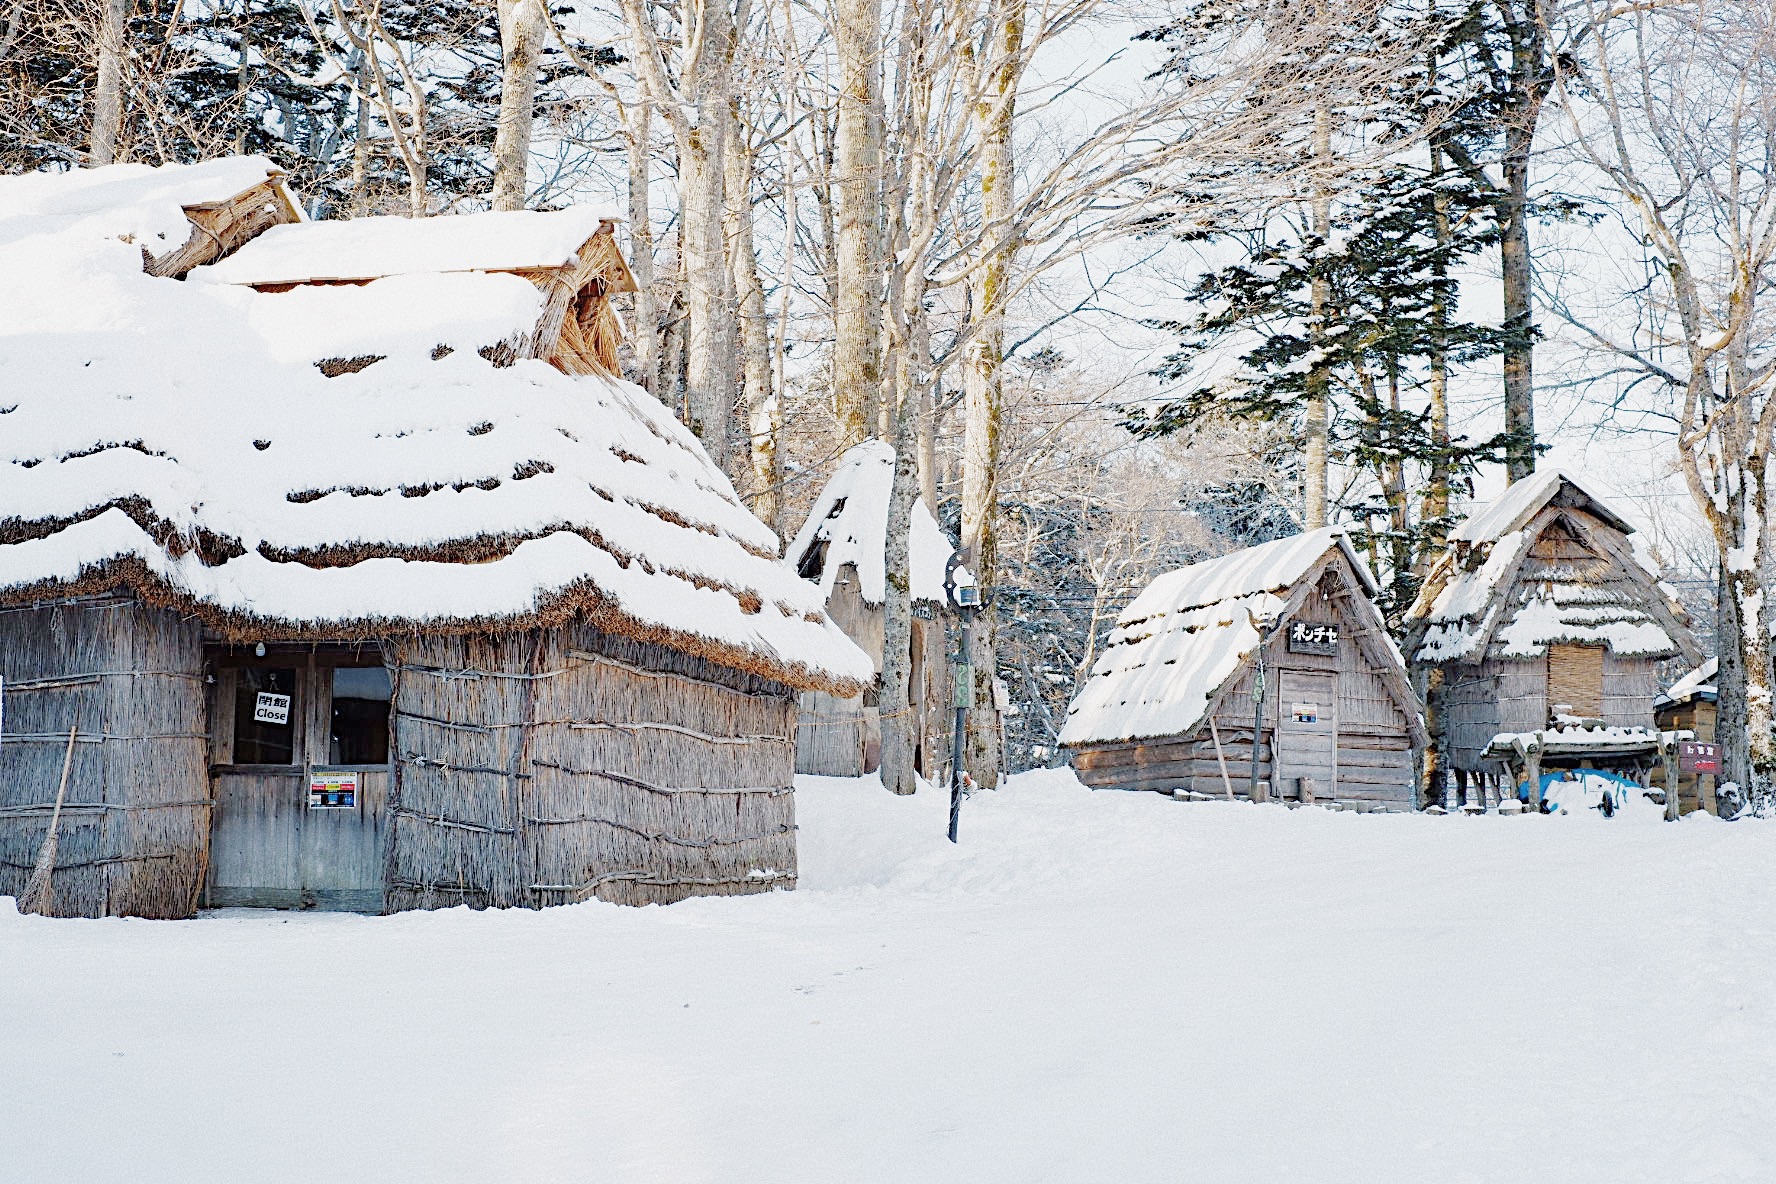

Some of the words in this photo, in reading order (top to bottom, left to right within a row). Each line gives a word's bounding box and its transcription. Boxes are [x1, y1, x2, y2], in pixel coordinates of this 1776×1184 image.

[1293, 623, 1338, 643] ポンチセ
[258, 695, 288, 708] 閉館
[256, 708, 286, 721] Close
